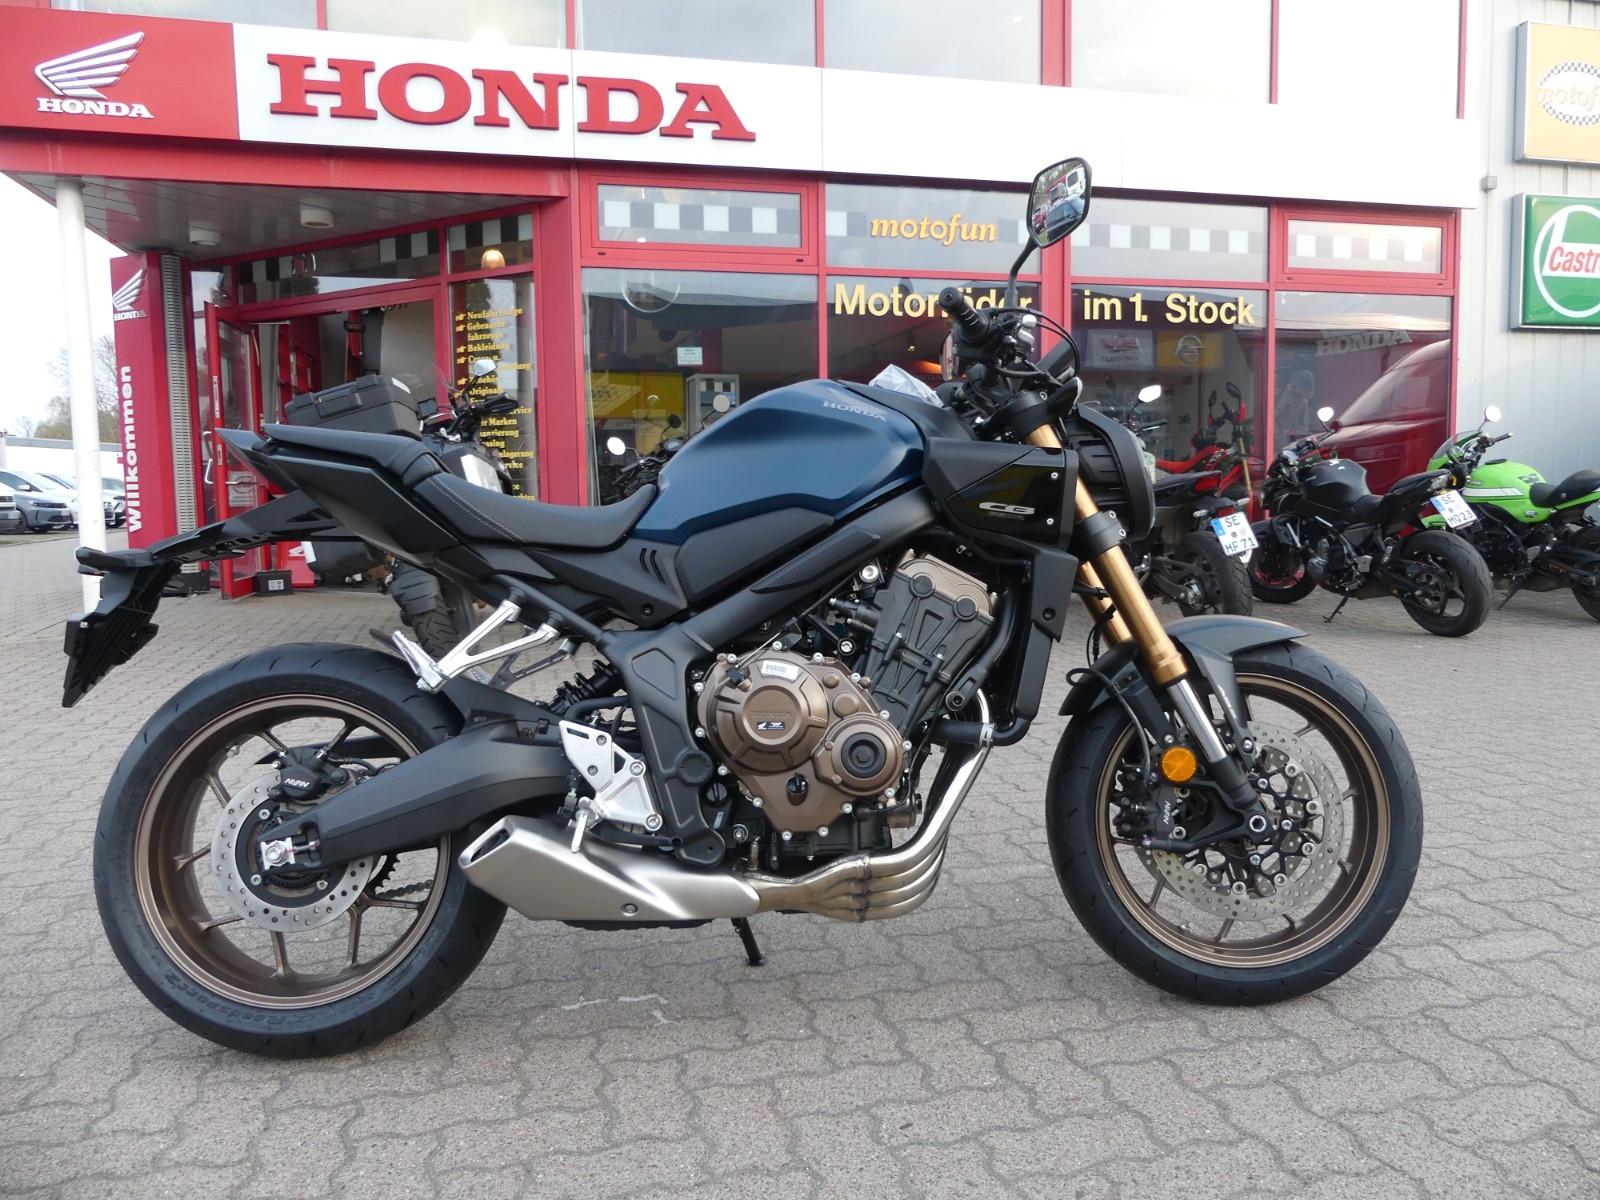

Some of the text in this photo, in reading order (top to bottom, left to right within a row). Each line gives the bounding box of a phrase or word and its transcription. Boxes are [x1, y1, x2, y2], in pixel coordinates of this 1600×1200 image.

[36, 97, 154, 119] HONDA
[267, 53, 756, 142] HONDA
[870, 212, 998, 247] motofun
[1548, 246, 1600, 274] Castr
[112, 310, 149, 321] HONDA
[1083, 289, 1255, 325] im 1. Stock
[823, 401, 888, 423] HONDA
[1440, 493, 1456, 505] SE
[1224, 515, 1241, 528] SE
[1240, 537, 1256, 549] 71
